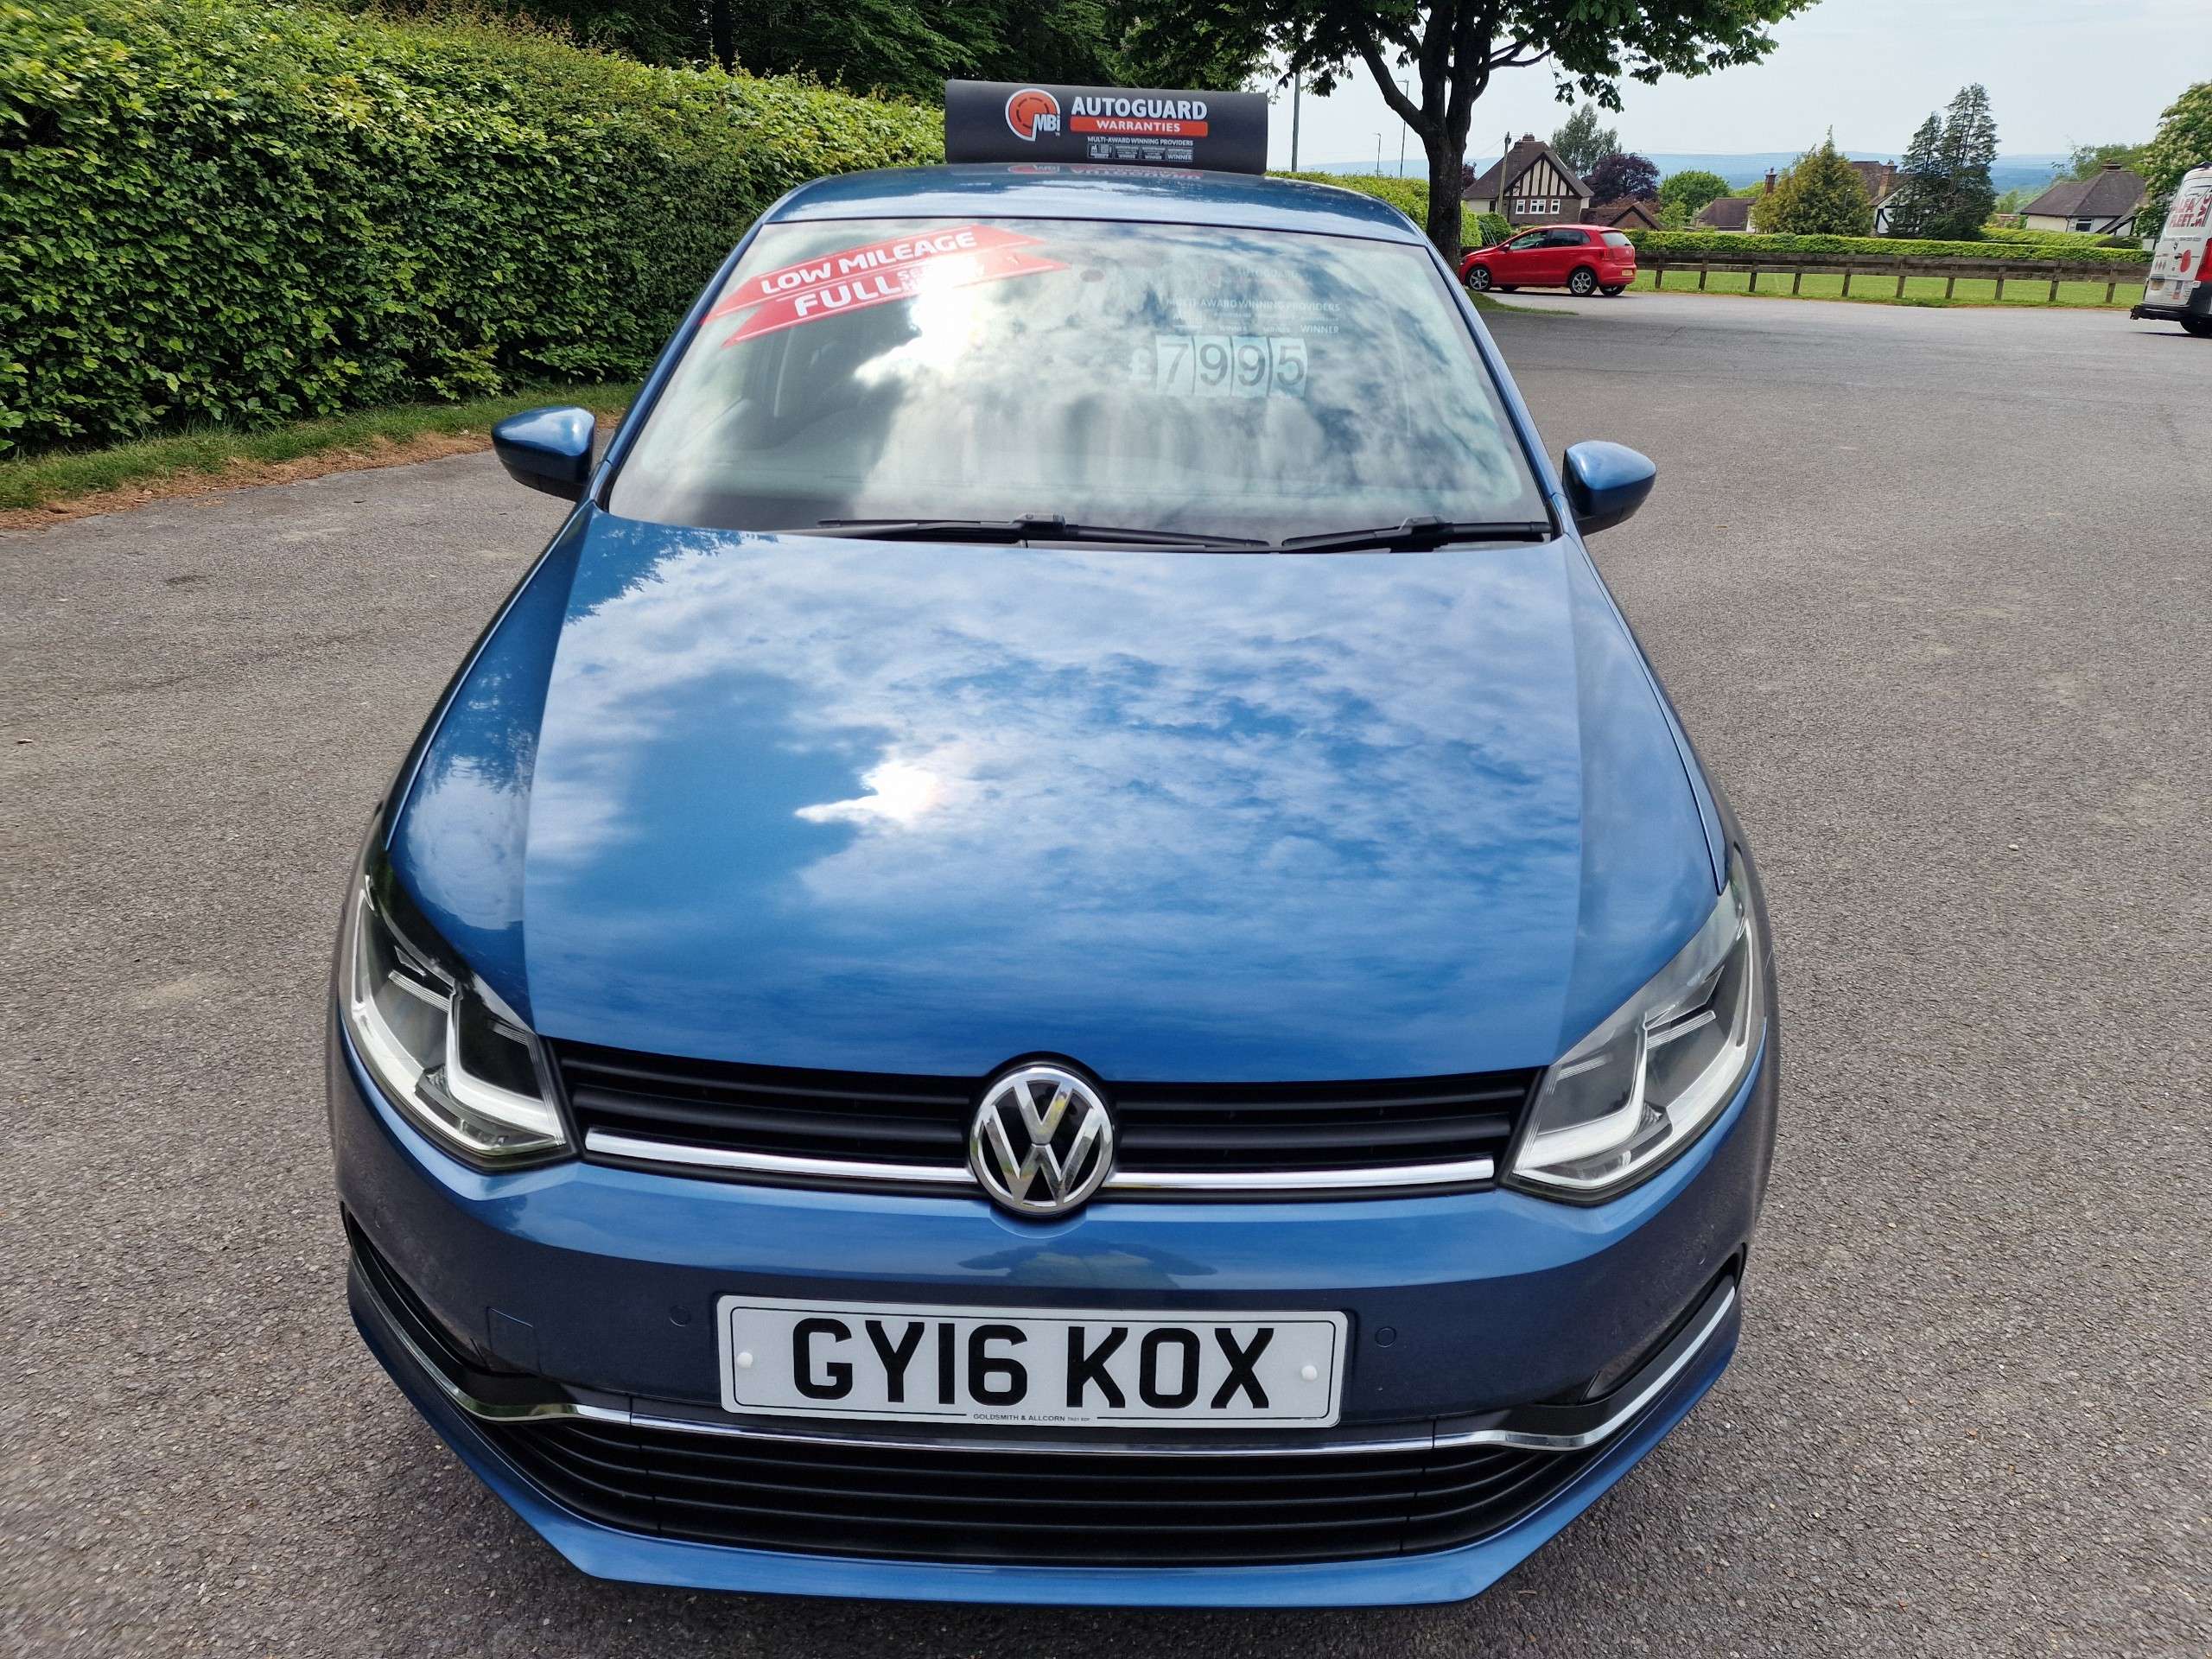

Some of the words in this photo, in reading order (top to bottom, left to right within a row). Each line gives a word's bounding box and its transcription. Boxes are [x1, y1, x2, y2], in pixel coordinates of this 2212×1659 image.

[1071, 97, 1207, 119] AUTOGUARD
[1096, 120, 1180, 132] WARRANTIES
[1087, 137, 1131, 145] MULTI-AWARD
[760, 263, 831, 295] LOW
[838, 232, 976, 274] MILEAGE
[794, 275, 902, 317] FULL
[792, 1317, 1028, 1407] GY16
[1066, 1325, 1275, 1409] KOX
[973, 1413, 1020, 1421] GOLDSMITH
